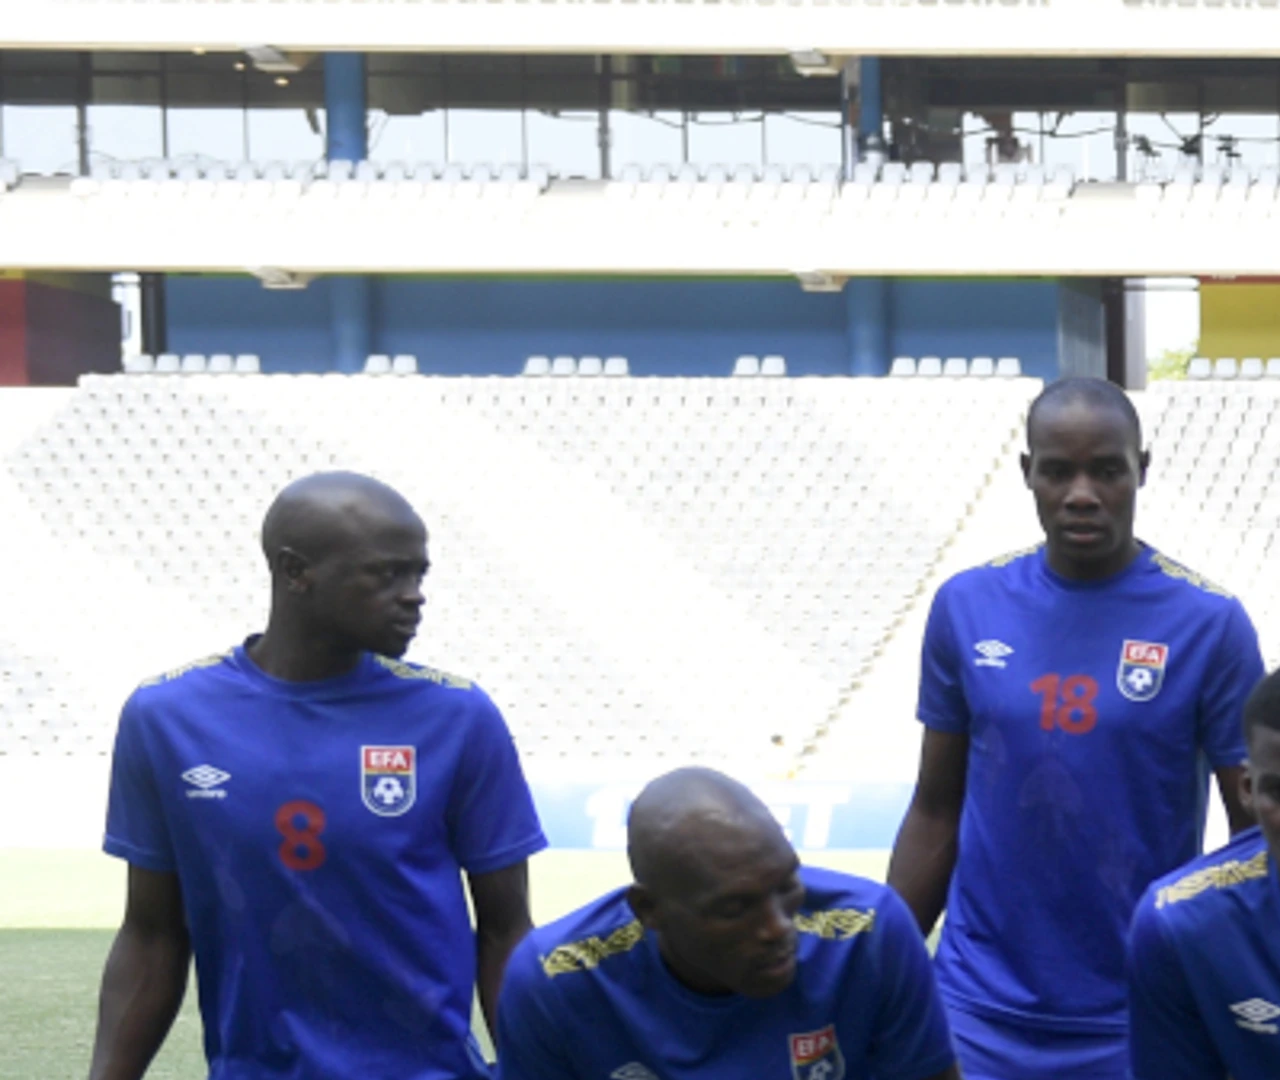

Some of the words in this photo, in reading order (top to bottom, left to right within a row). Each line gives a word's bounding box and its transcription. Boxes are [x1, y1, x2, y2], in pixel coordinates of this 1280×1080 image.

[1131, 643, 1160, 662] EFA
[1030, 674, 1099, 735] 18
[370, 751, 407, 768] EFA
[276, 801, 327, 871] 8
